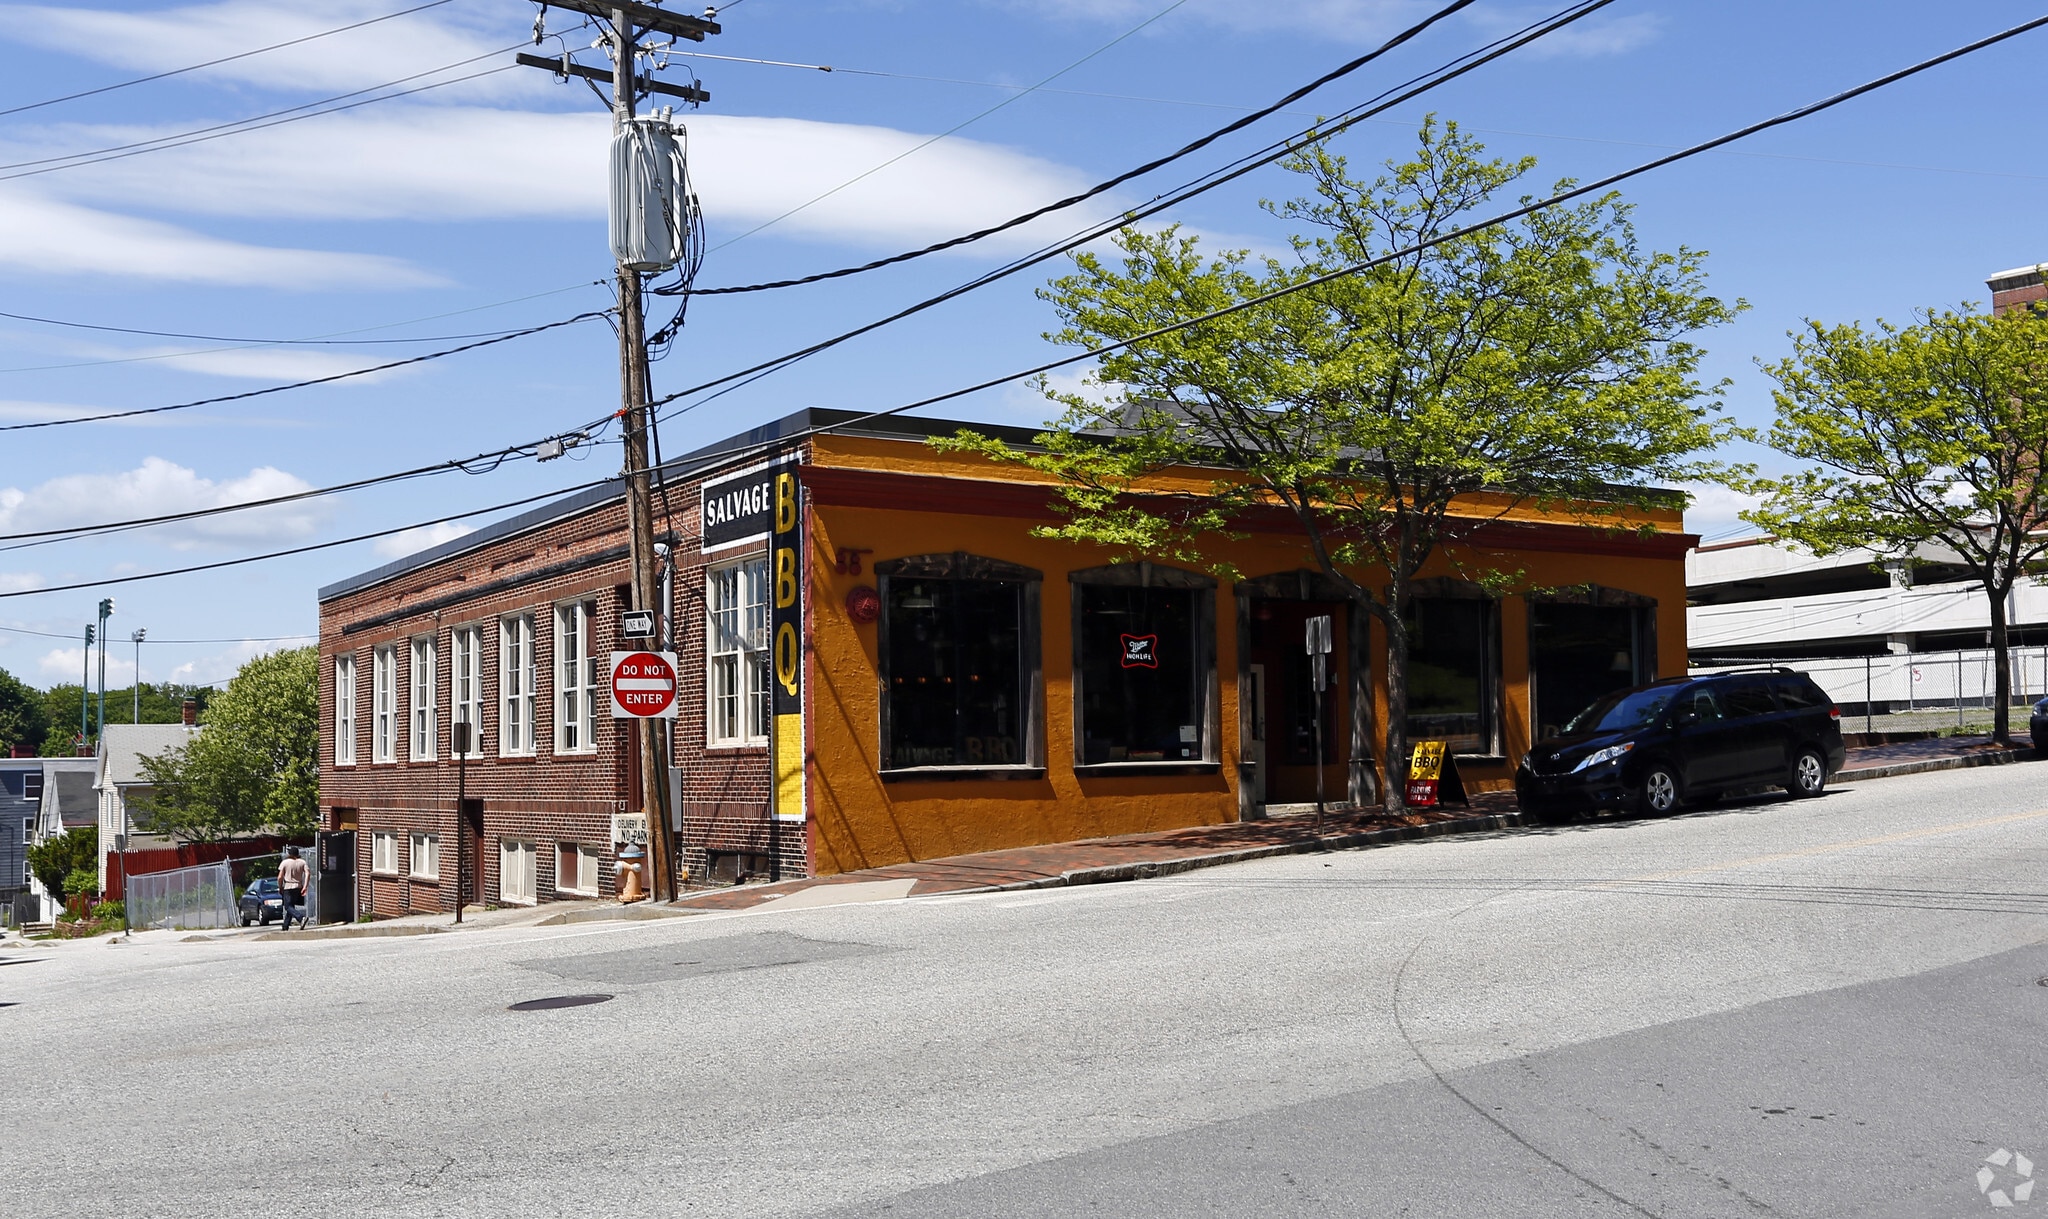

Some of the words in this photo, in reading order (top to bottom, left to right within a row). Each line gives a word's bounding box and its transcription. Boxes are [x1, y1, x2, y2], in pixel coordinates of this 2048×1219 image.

[707, 482, 770, 527] SALVAGE
[774, 471, 798, 698] BBQ
[626, 620, 636, 630] ONE
[637, 619, 647, 629] WAY
[622, 664, 638, 676] DO
[643, 664, 666, 676] NOT
[625, 693, 663, 705] ENTER
[1415, 757, 1440, 770] BBQ
[618, 819, 637, 829] DELIVERY
